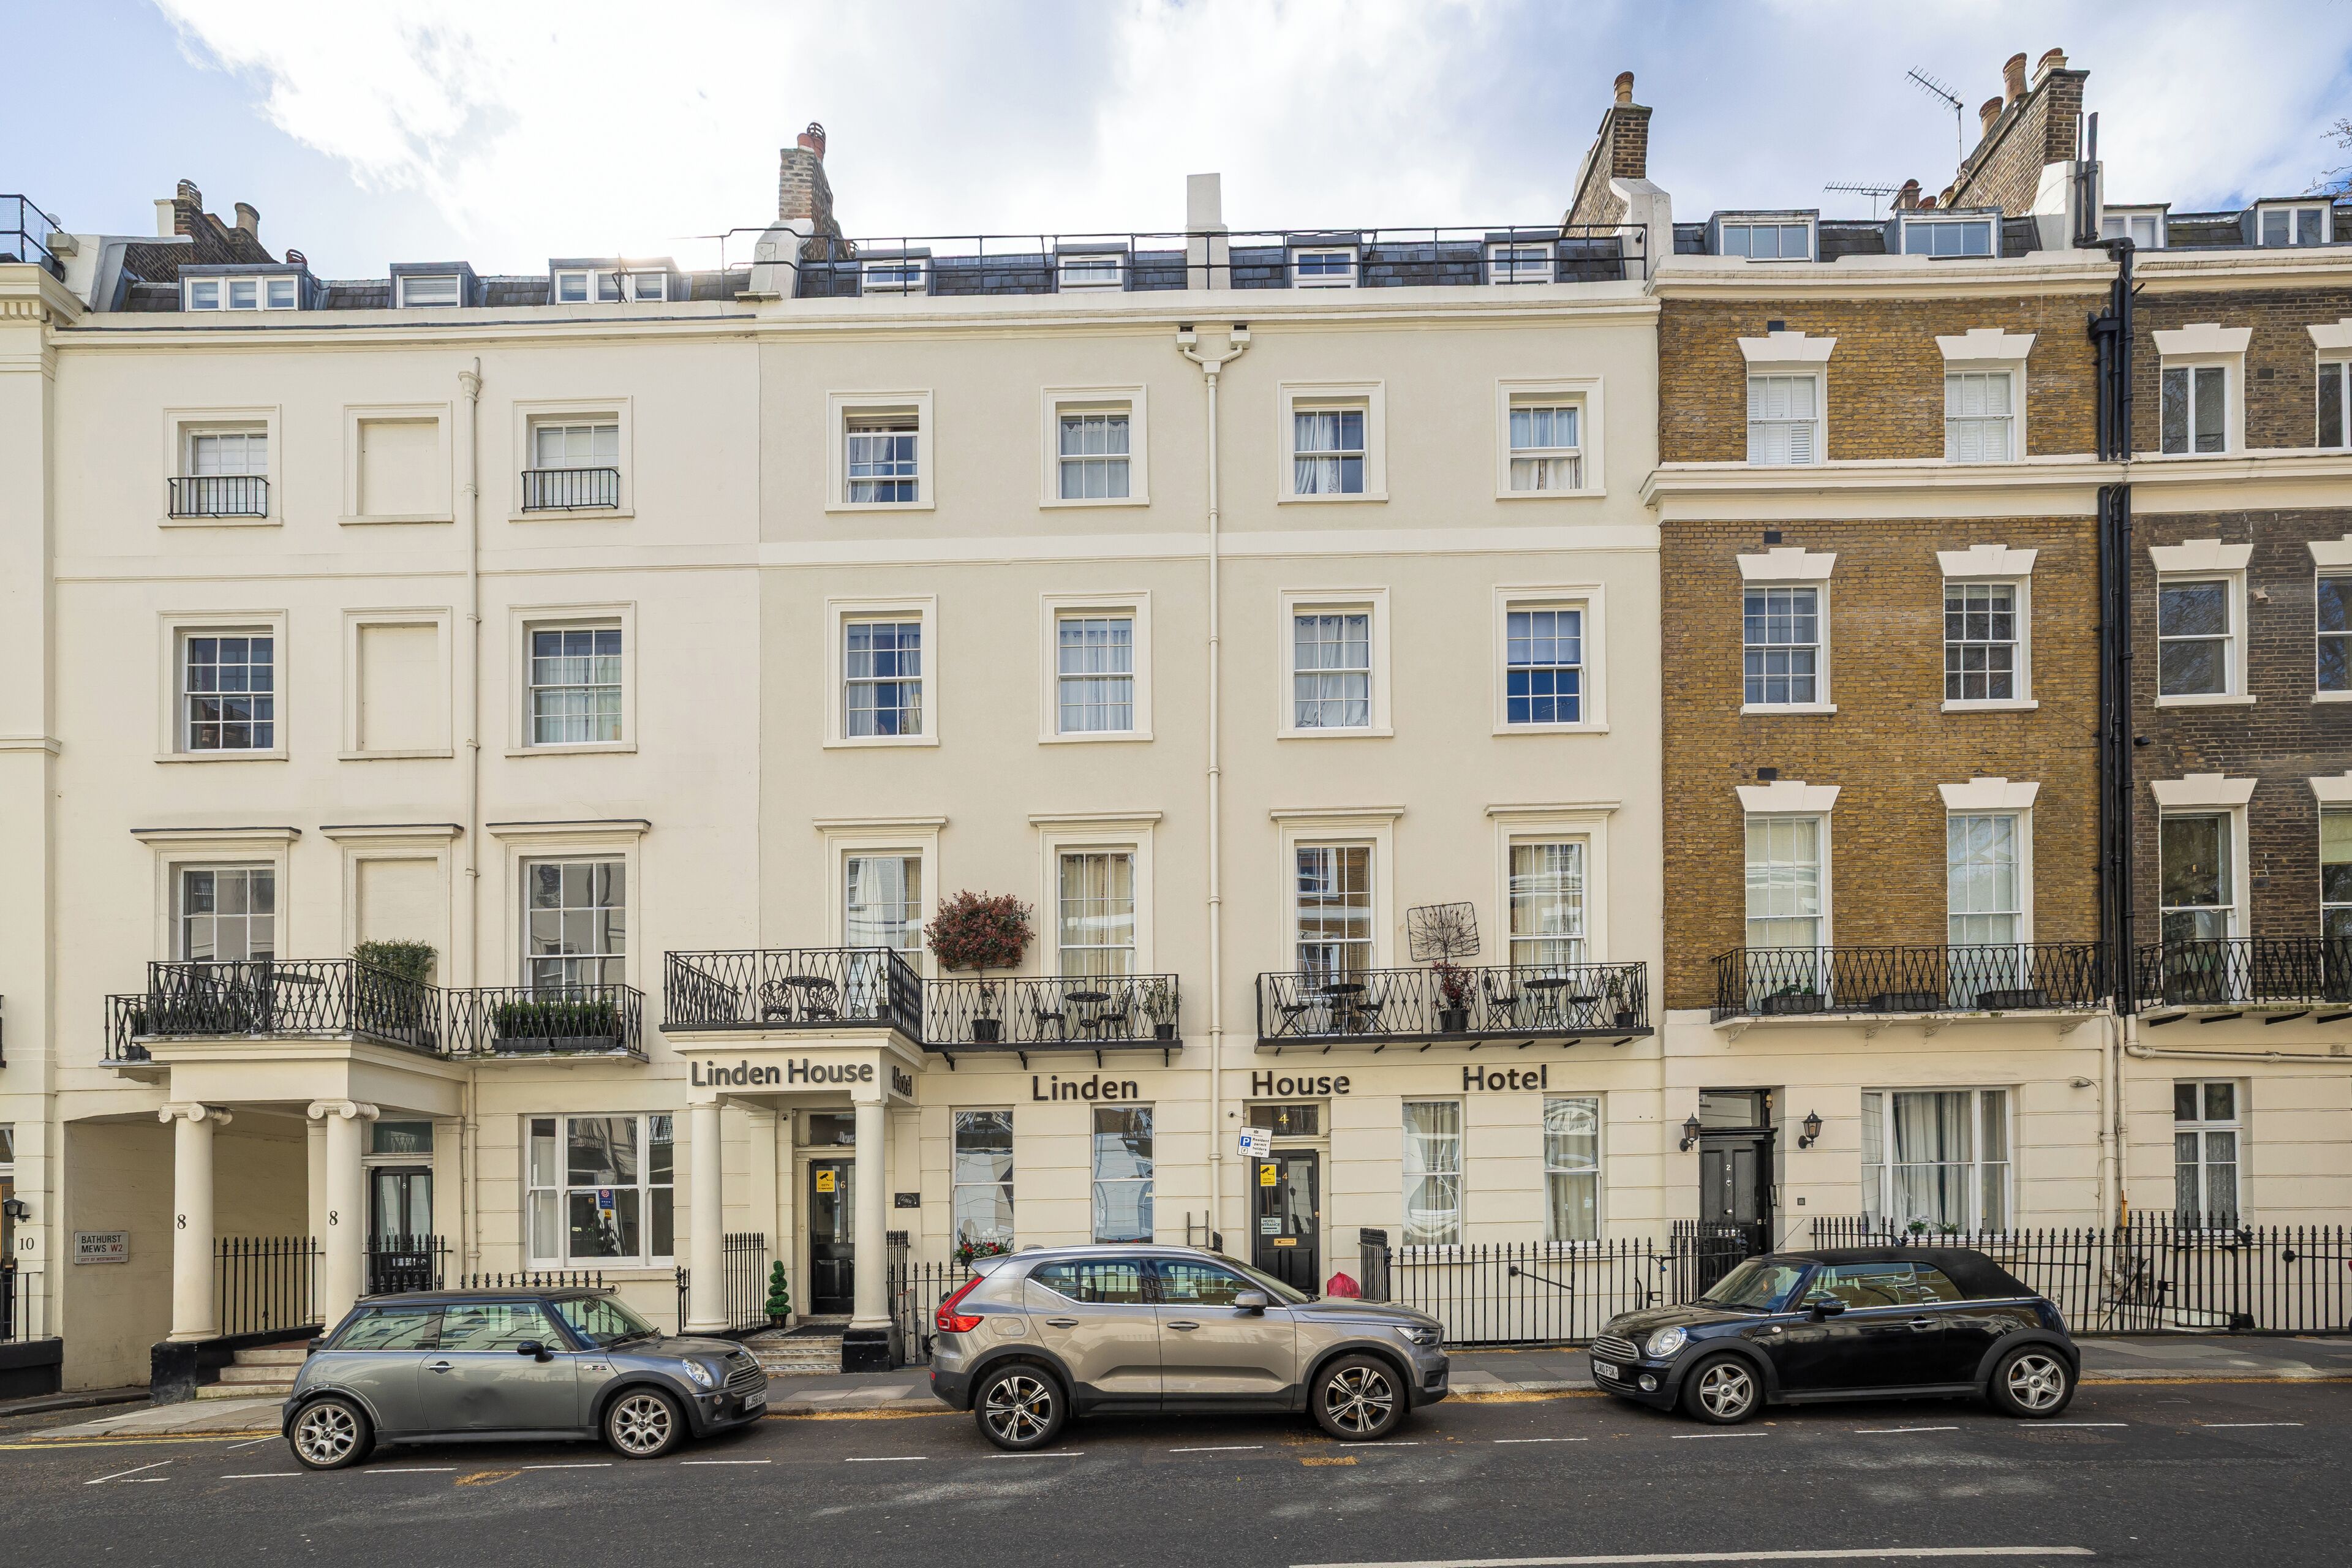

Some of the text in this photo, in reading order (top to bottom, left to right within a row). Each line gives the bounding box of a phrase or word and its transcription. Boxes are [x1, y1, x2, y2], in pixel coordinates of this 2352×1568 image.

[692, 1058, 873, 1086] Linden House
[892, 1065, 912, 1097] Hotel
[1033, 1064, 1547, 1101] Linden House Hotel
[1278, 1114, 1289, 1124] 4
[177, 1214, 186, 1229] 8
[330, 1210, 338, 1226] 8
[19, 1237, 34, 1250] 10
[81, 1235, 122, 1243] BATHURST
[81, 1245, 107, 1253] MEWS
[1605, 1365, 1616, 1378] FSK
[747, 1394, 759, 1408] LJ56
